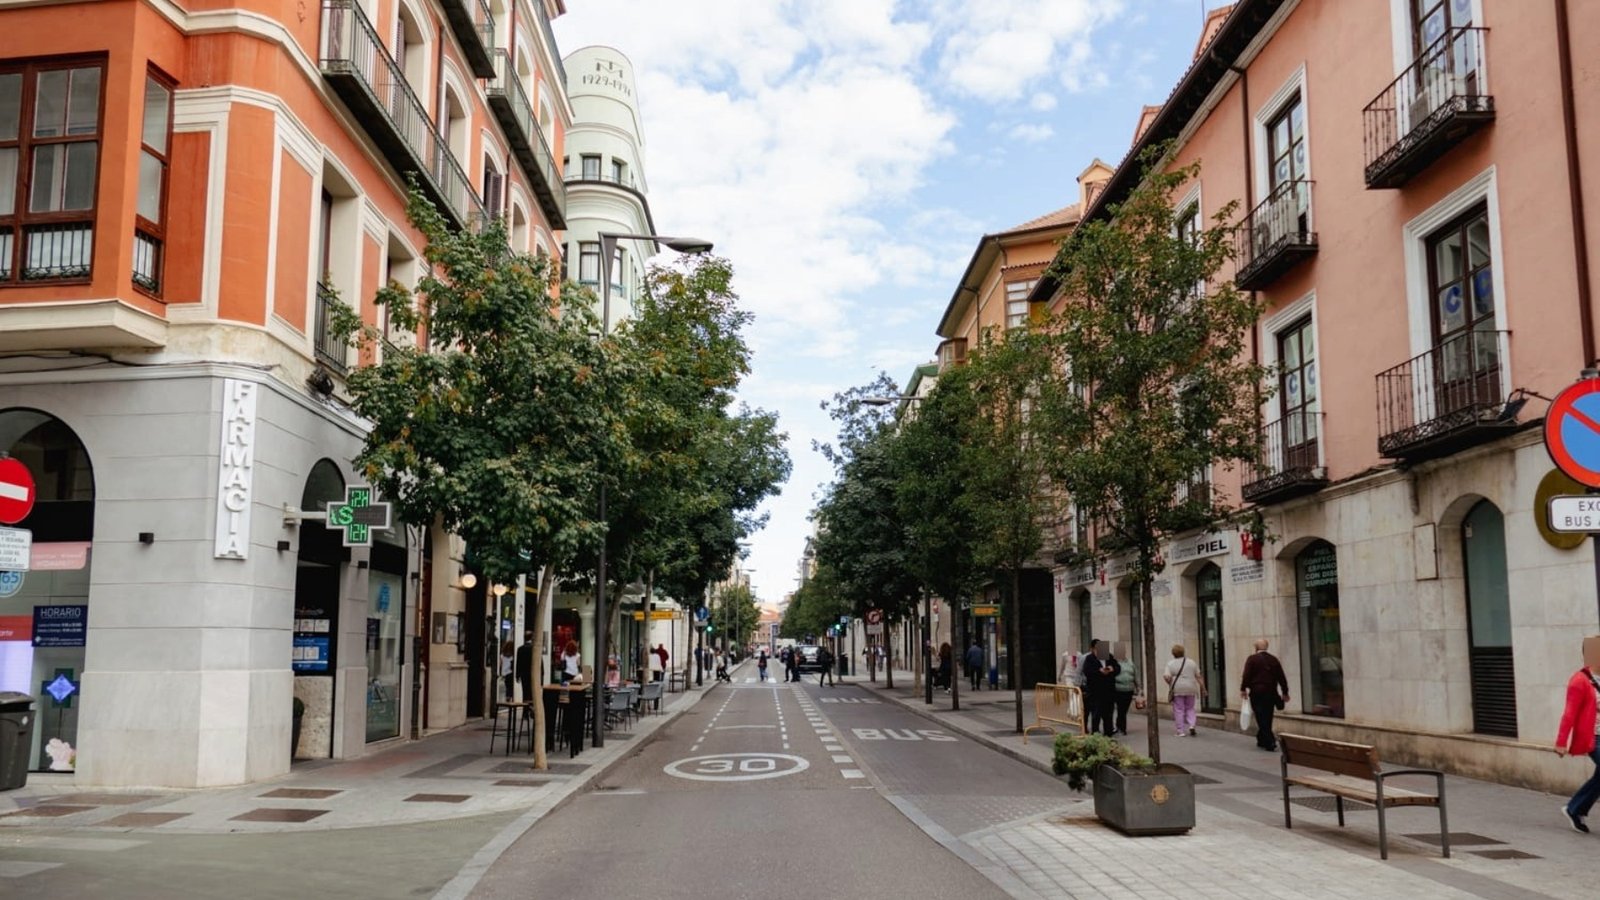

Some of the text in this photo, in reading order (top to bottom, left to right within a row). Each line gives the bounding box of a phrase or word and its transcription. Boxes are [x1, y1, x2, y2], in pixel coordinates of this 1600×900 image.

[219, 380, 252, 558] FARMACIA
[1565, 516, 1592, 527] BUS
[1197, 540, 1227, 554] PIEL
[1125, 560, 1141, 571] PIE
[40, 607, 82, 617] HORARIO
[851, 728, 960, 742] BUS
[696, 758, 776, 774] 30
